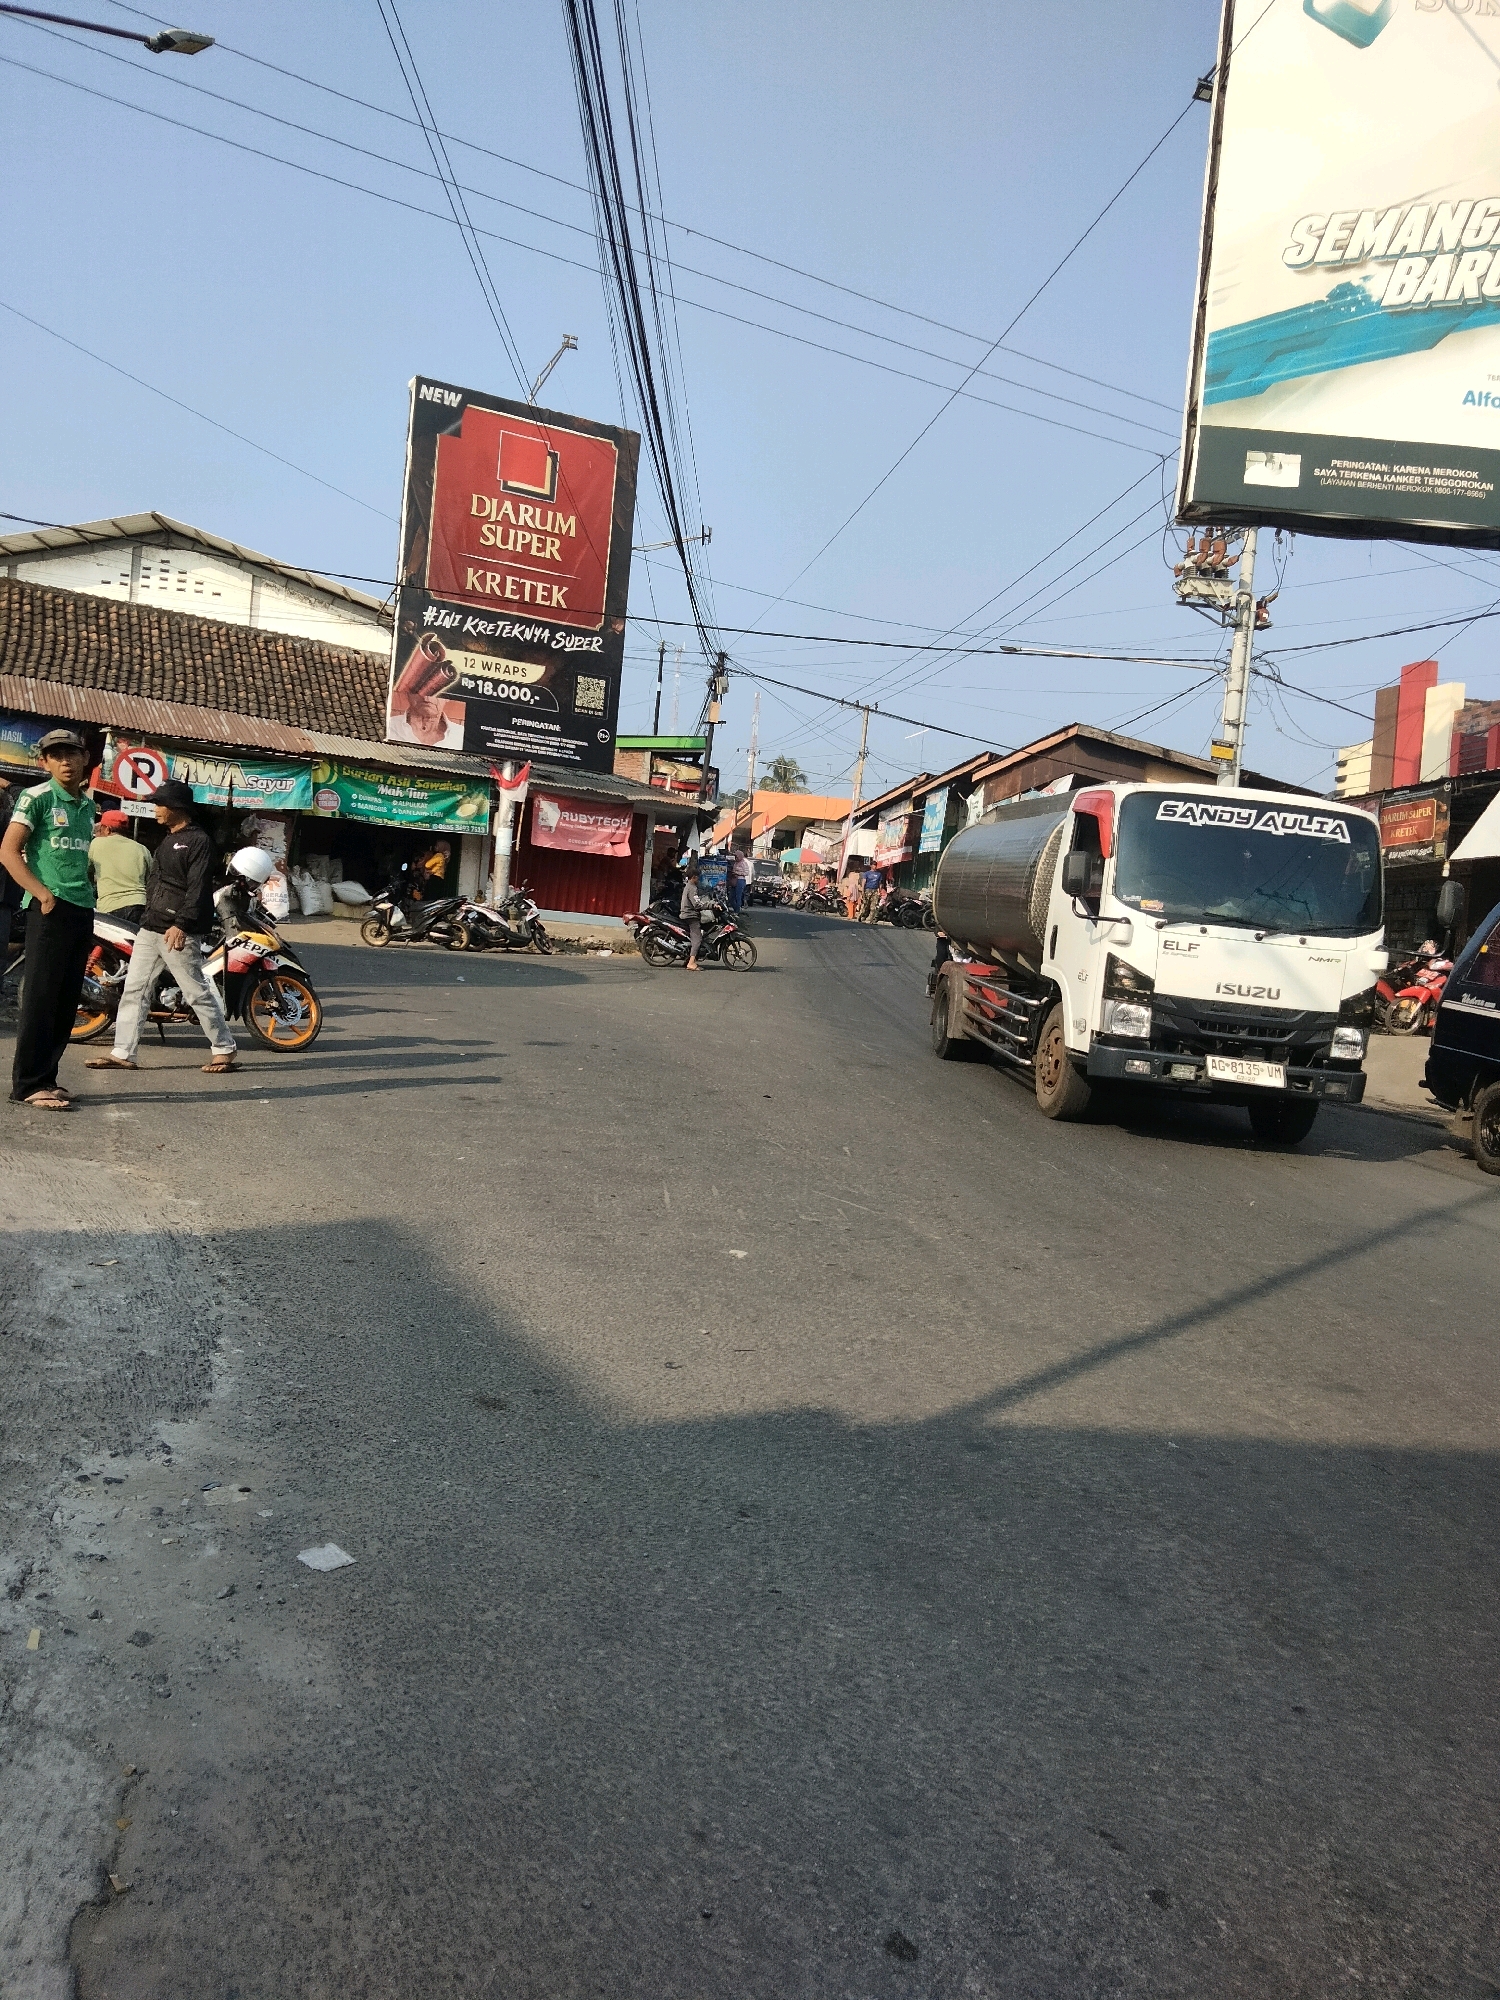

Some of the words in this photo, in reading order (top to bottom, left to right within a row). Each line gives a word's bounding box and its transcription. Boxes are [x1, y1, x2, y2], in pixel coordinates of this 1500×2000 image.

[419, 384, 462, 408] NEW
[1313, 468, 1338, 478] SAYA
[1339, 471, 1382, 482] TERKENA
[1383, 474, 1422, 485] KANKER
[1423, 476, 1494, 491] TENGGOROKAN
[1330, 459, 1391, 473] PERINGATAN:
[1393, 465, 1431, 476] KARENA
[1432, 467, 1479, 480] MEROKOK
[1320, 477, 1356, 488] (LAYANAN
[1357, 480, 1394, 491] BERHENTI
[1395, 483, 1433, 494] MEROKOK
[470, 493, 577, 538] DJARUM
[479, 523, 562, 561] SUPER
[465, 567, 569, 609] KRETEK
[422, 605, 463, 629] #INI
[551, 631, 605, 654] SUPER
[463, 657, 476, 669] 12
[481, 660, 528, 678] WRAPS
[461, 677, 476, 689] Rp
[477, 680, 540, 705] 18.000,-
[511, 717, 562, 732] PERINGATAN:
[247, 775, 295, 794] Sayur
[342, 765, 384, 783] Durian
[130, 803, 147, 814] 25m
[560, 811, 629, 828] RUBYTECH
[1157, 801, 1256, 828] SANDY
[1255, 812, 1350, 843] AULIA
[1162, 939, 1201, 952] ELF
[1215, 981, 1281, 1001] ISUZU
[1211, 1058, 1226, 1072] AG
[1230, 1061, 1260, 1077] 8135
